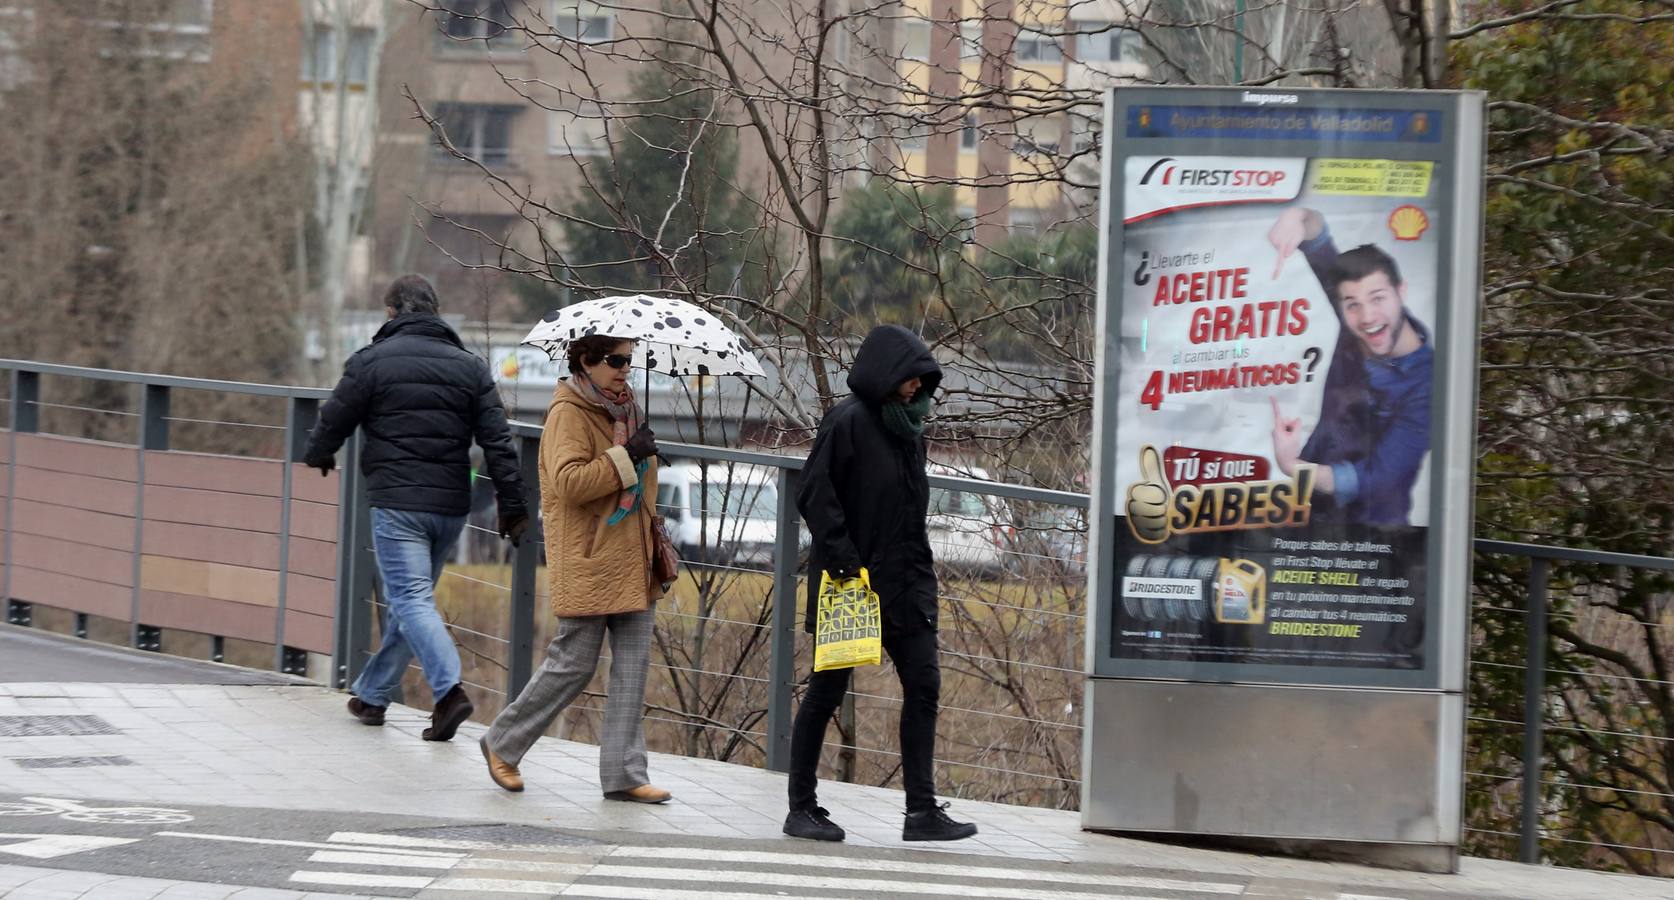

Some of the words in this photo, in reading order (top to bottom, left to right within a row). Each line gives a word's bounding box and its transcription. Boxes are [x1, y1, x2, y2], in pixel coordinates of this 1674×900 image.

[1242, 91, 1298, 105] impursa
[1170, 112, 1281, 131] Ayuntamiento
[1286, 114, 1306, 130] de
[1311, 114, 1394, 133] Valladolid
[1203, 249, 1215, 265] el
[1153, 267, 1249, 307] ACEITE
[1189, 298, 1310, 345] GRATIS
[1172, 352, 1181, 365] al
[1184, 348, 1229, 364] cambiar
[1141, 370, 1164, 411] 4
[1173, 451, 1200, 481] TÚ
[1223, 460, 1256, 479] QUE
[1171, 468, 1311, 530] SABES!
[1274, 538, 1308, 551] Porque
[1310, 540, 1338, 551] sabes
[1341, 541, 1354, 551] de
[1273, 557, 1285, 566] en
[1287, 555, 1309, 567] First
[1311, 557, 1333, 569] Stop
[1370, 560, 1379, 570] el
[1272, 570, 1316, 584] ACEITE
[1318, 572, 1360, 586] SHELL
[1362, 576, 1375, 587] de
[1378, 577, 1409, 590] regalo
[1129, 582, 1196, 595] BRIDGESTONE
[1272, 592, 1284, 601] en
[1286, 591, 1296, 601] tu
[1341, 594, 1415, 606] mantenimiento
[1271, 608, 1280, 618] al
[1282, 608, 1320, 619] cambiar
[1322, 609, 1338, 620] tus
[1350, 611, 1407, 623] neumáticos
[1270, 622, 1363, 638] BRIDGESTONE
